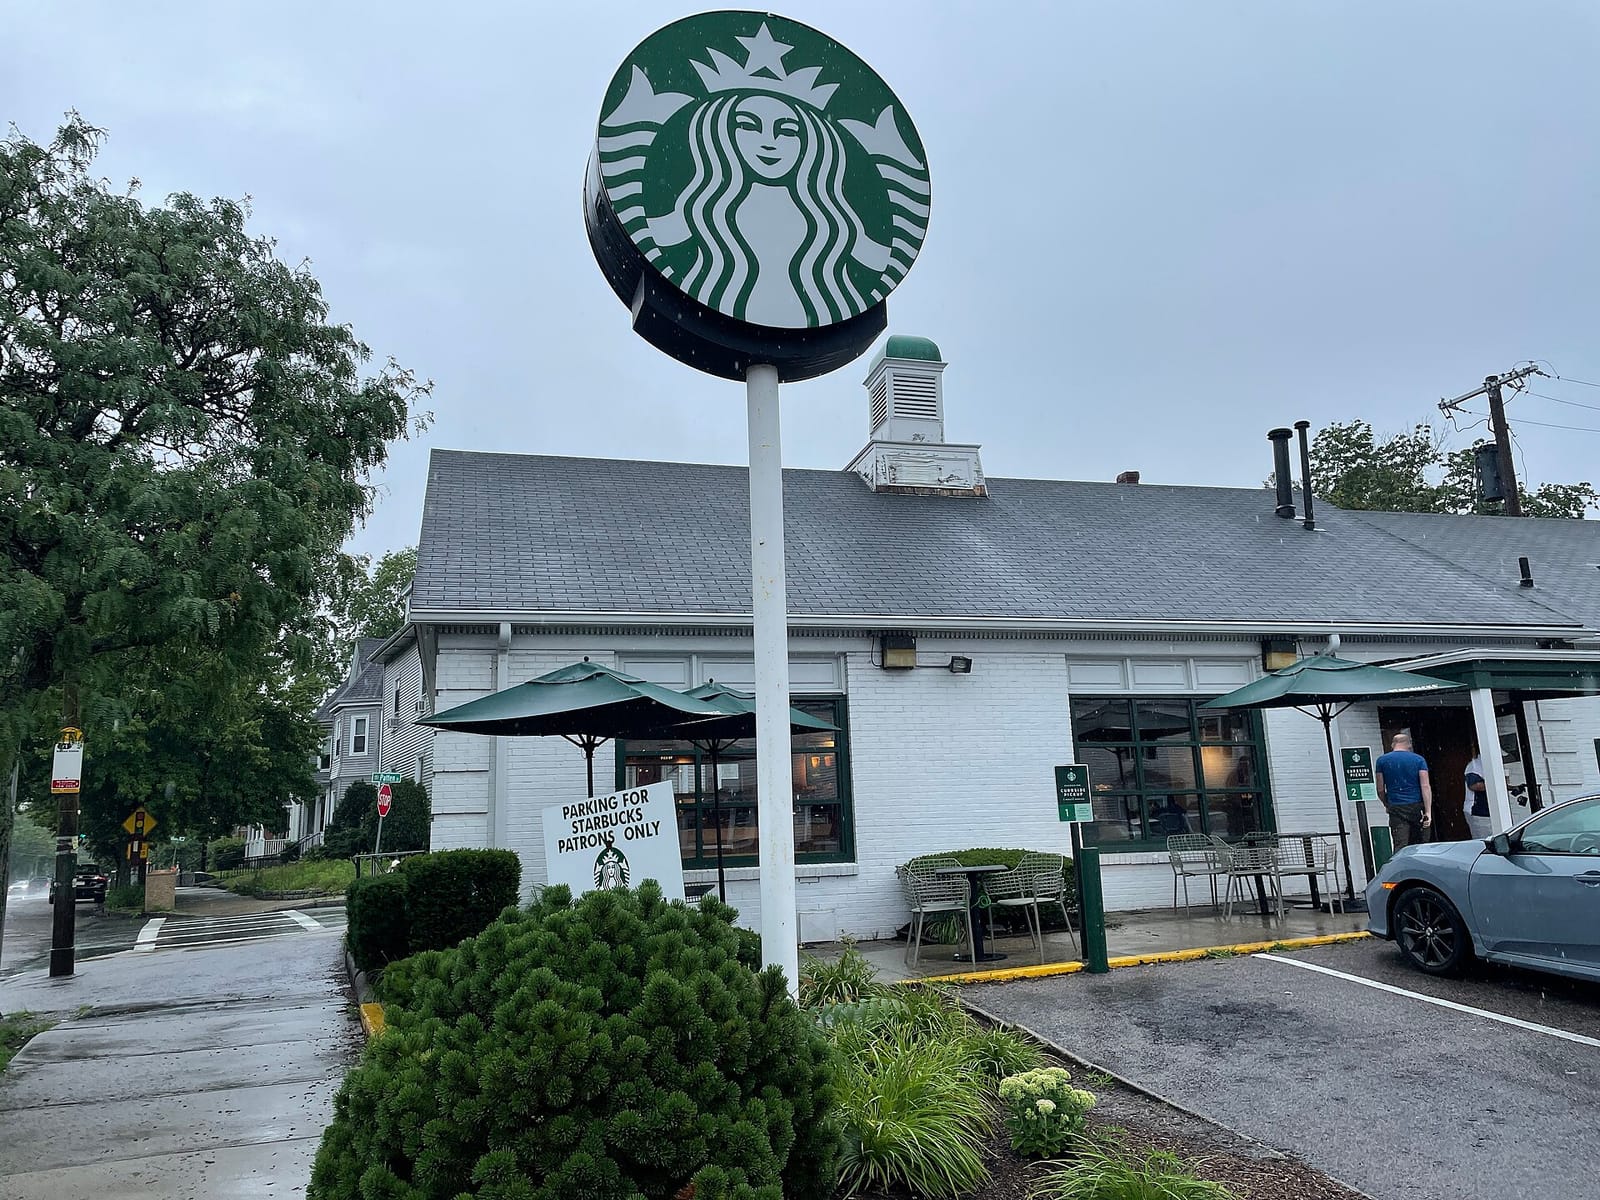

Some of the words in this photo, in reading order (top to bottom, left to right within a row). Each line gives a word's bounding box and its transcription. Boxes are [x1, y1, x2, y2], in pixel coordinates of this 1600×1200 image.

[379, 794, 391, 807] STOP
[1351, 787, 1358, 797] 2
[562, 795, 618, 820] PARKING
[622, 789, 649, 807] FOR
[1065, 808, 1069, 817] 1
[571, 807, 643, 834] STARBUCKS
[558, 829, 615, 854] PATRONS
[624, 820, 661, 841] ONLY
